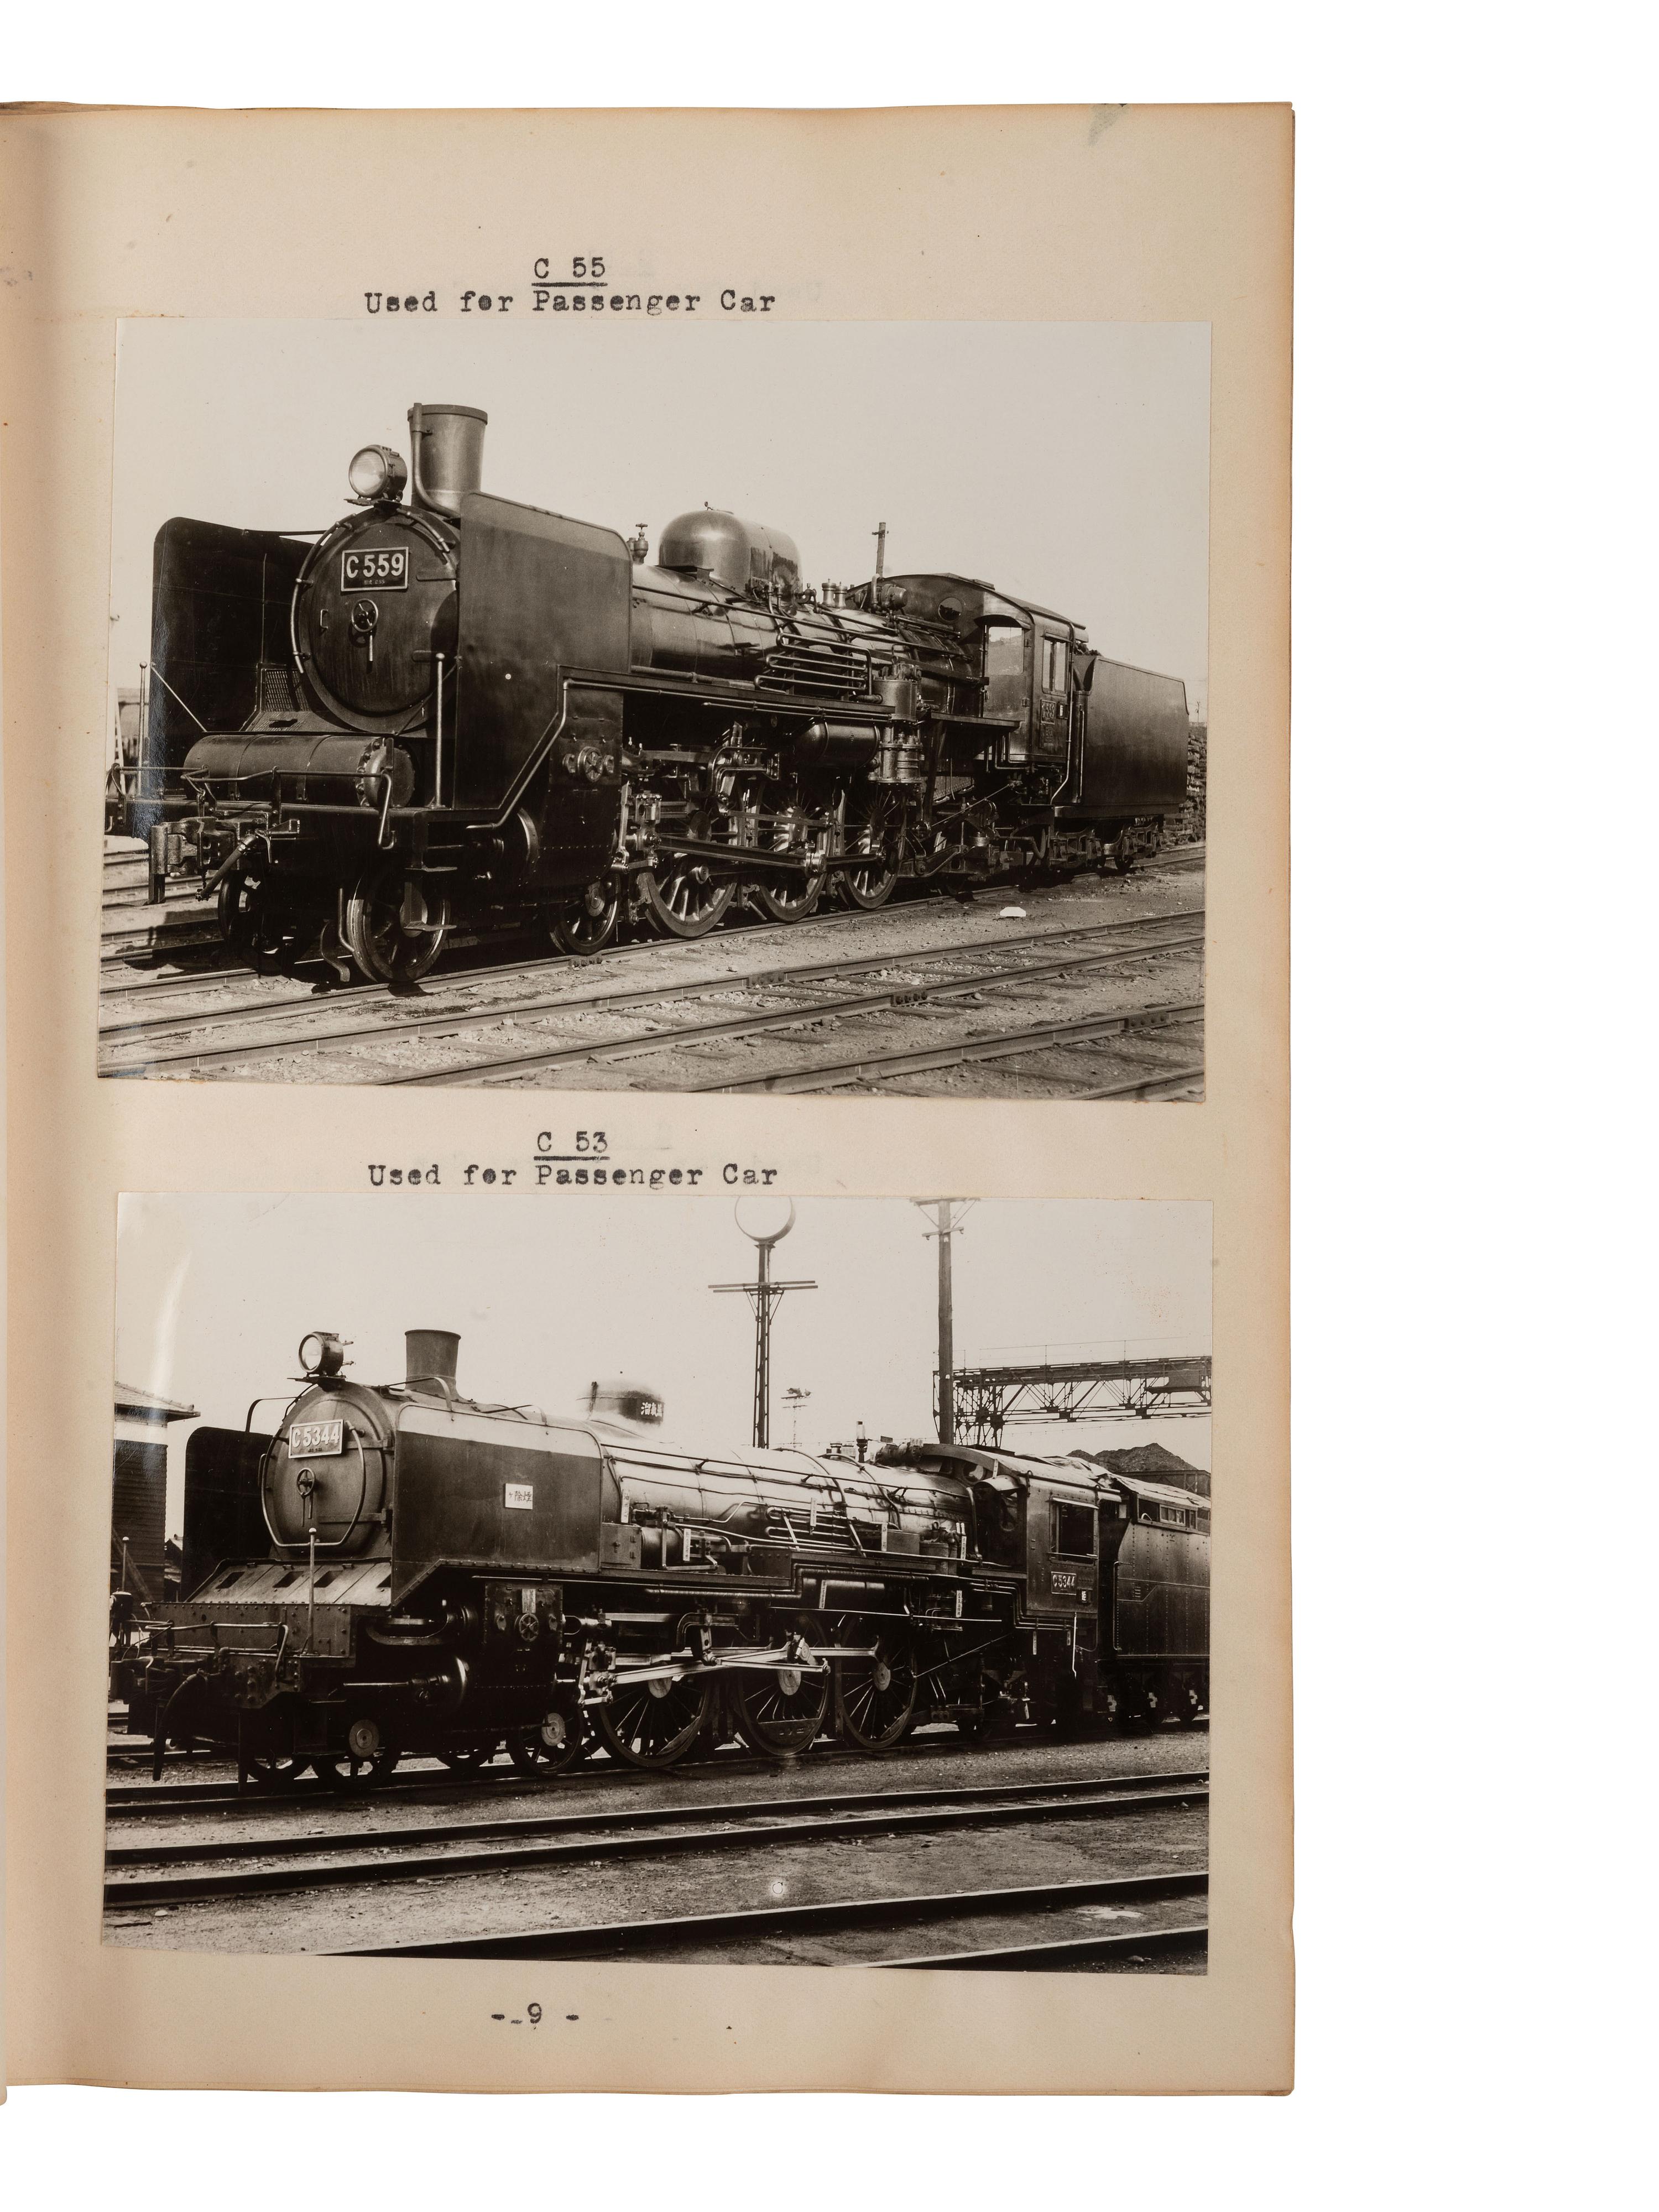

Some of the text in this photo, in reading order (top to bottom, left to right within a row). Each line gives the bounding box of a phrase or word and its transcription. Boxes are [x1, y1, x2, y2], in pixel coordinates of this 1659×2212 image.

[534, 257, 606, 279] C 55
[364, 289, 775, 316] Used for Passenger Car
[537, 1131, 608, 1153] C 53
[368, 1163, 778, 1190] Used for Passenger Car
[292, 1424, 340, 1448] C5344
[1052, 1574, 1075, 1588] C5344
